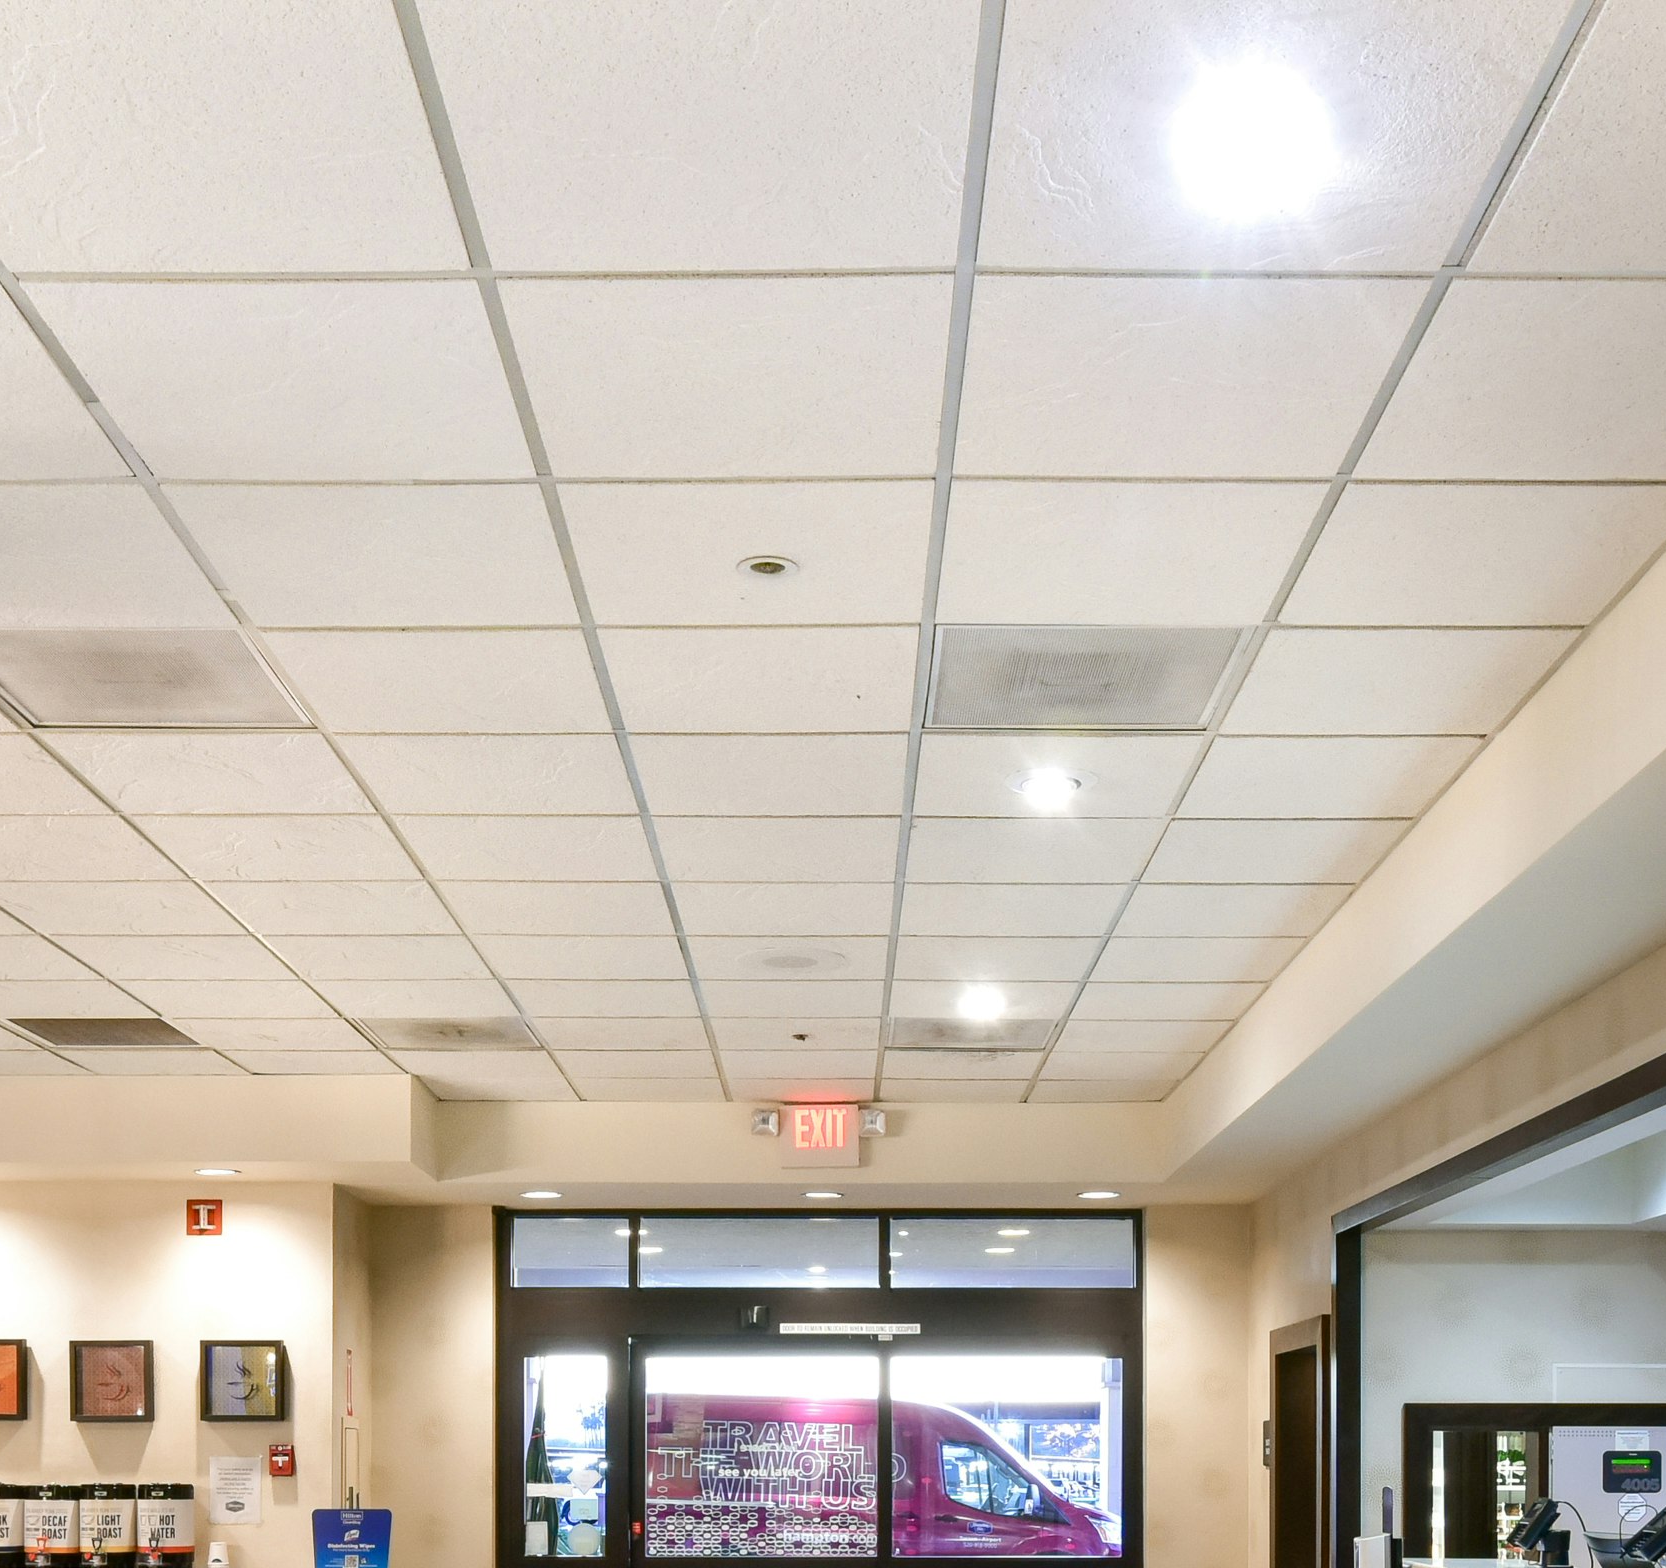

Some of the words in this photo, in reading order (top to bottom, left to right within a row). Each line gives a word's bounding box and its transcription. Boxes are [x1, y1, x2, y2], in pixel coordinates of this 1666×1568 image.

[794, 1108, 847, 1148] EXIT
[703, 1421, 864, 1453] TRAVEL
[658, 1447, 737, 1478] THE
[718, 1468, 740, 1477] see
[743, 1468, 768, 1479] you
[1621, 1478, 1660, 1492] 4005
[700, 1476, 807, 1509] WITH
[821, 1479, 876, 1511] US
[41, 1515, 68, 1527] DECAF
[96, 1514, 121, 1526] LIGHT
[159, 1514, 176, 1526] HOT
[41, 1528, 68, 1540] ROAST
[96, 1527, 122, 1539] ROAST
[150, 1527, 176, 1539] WATER
